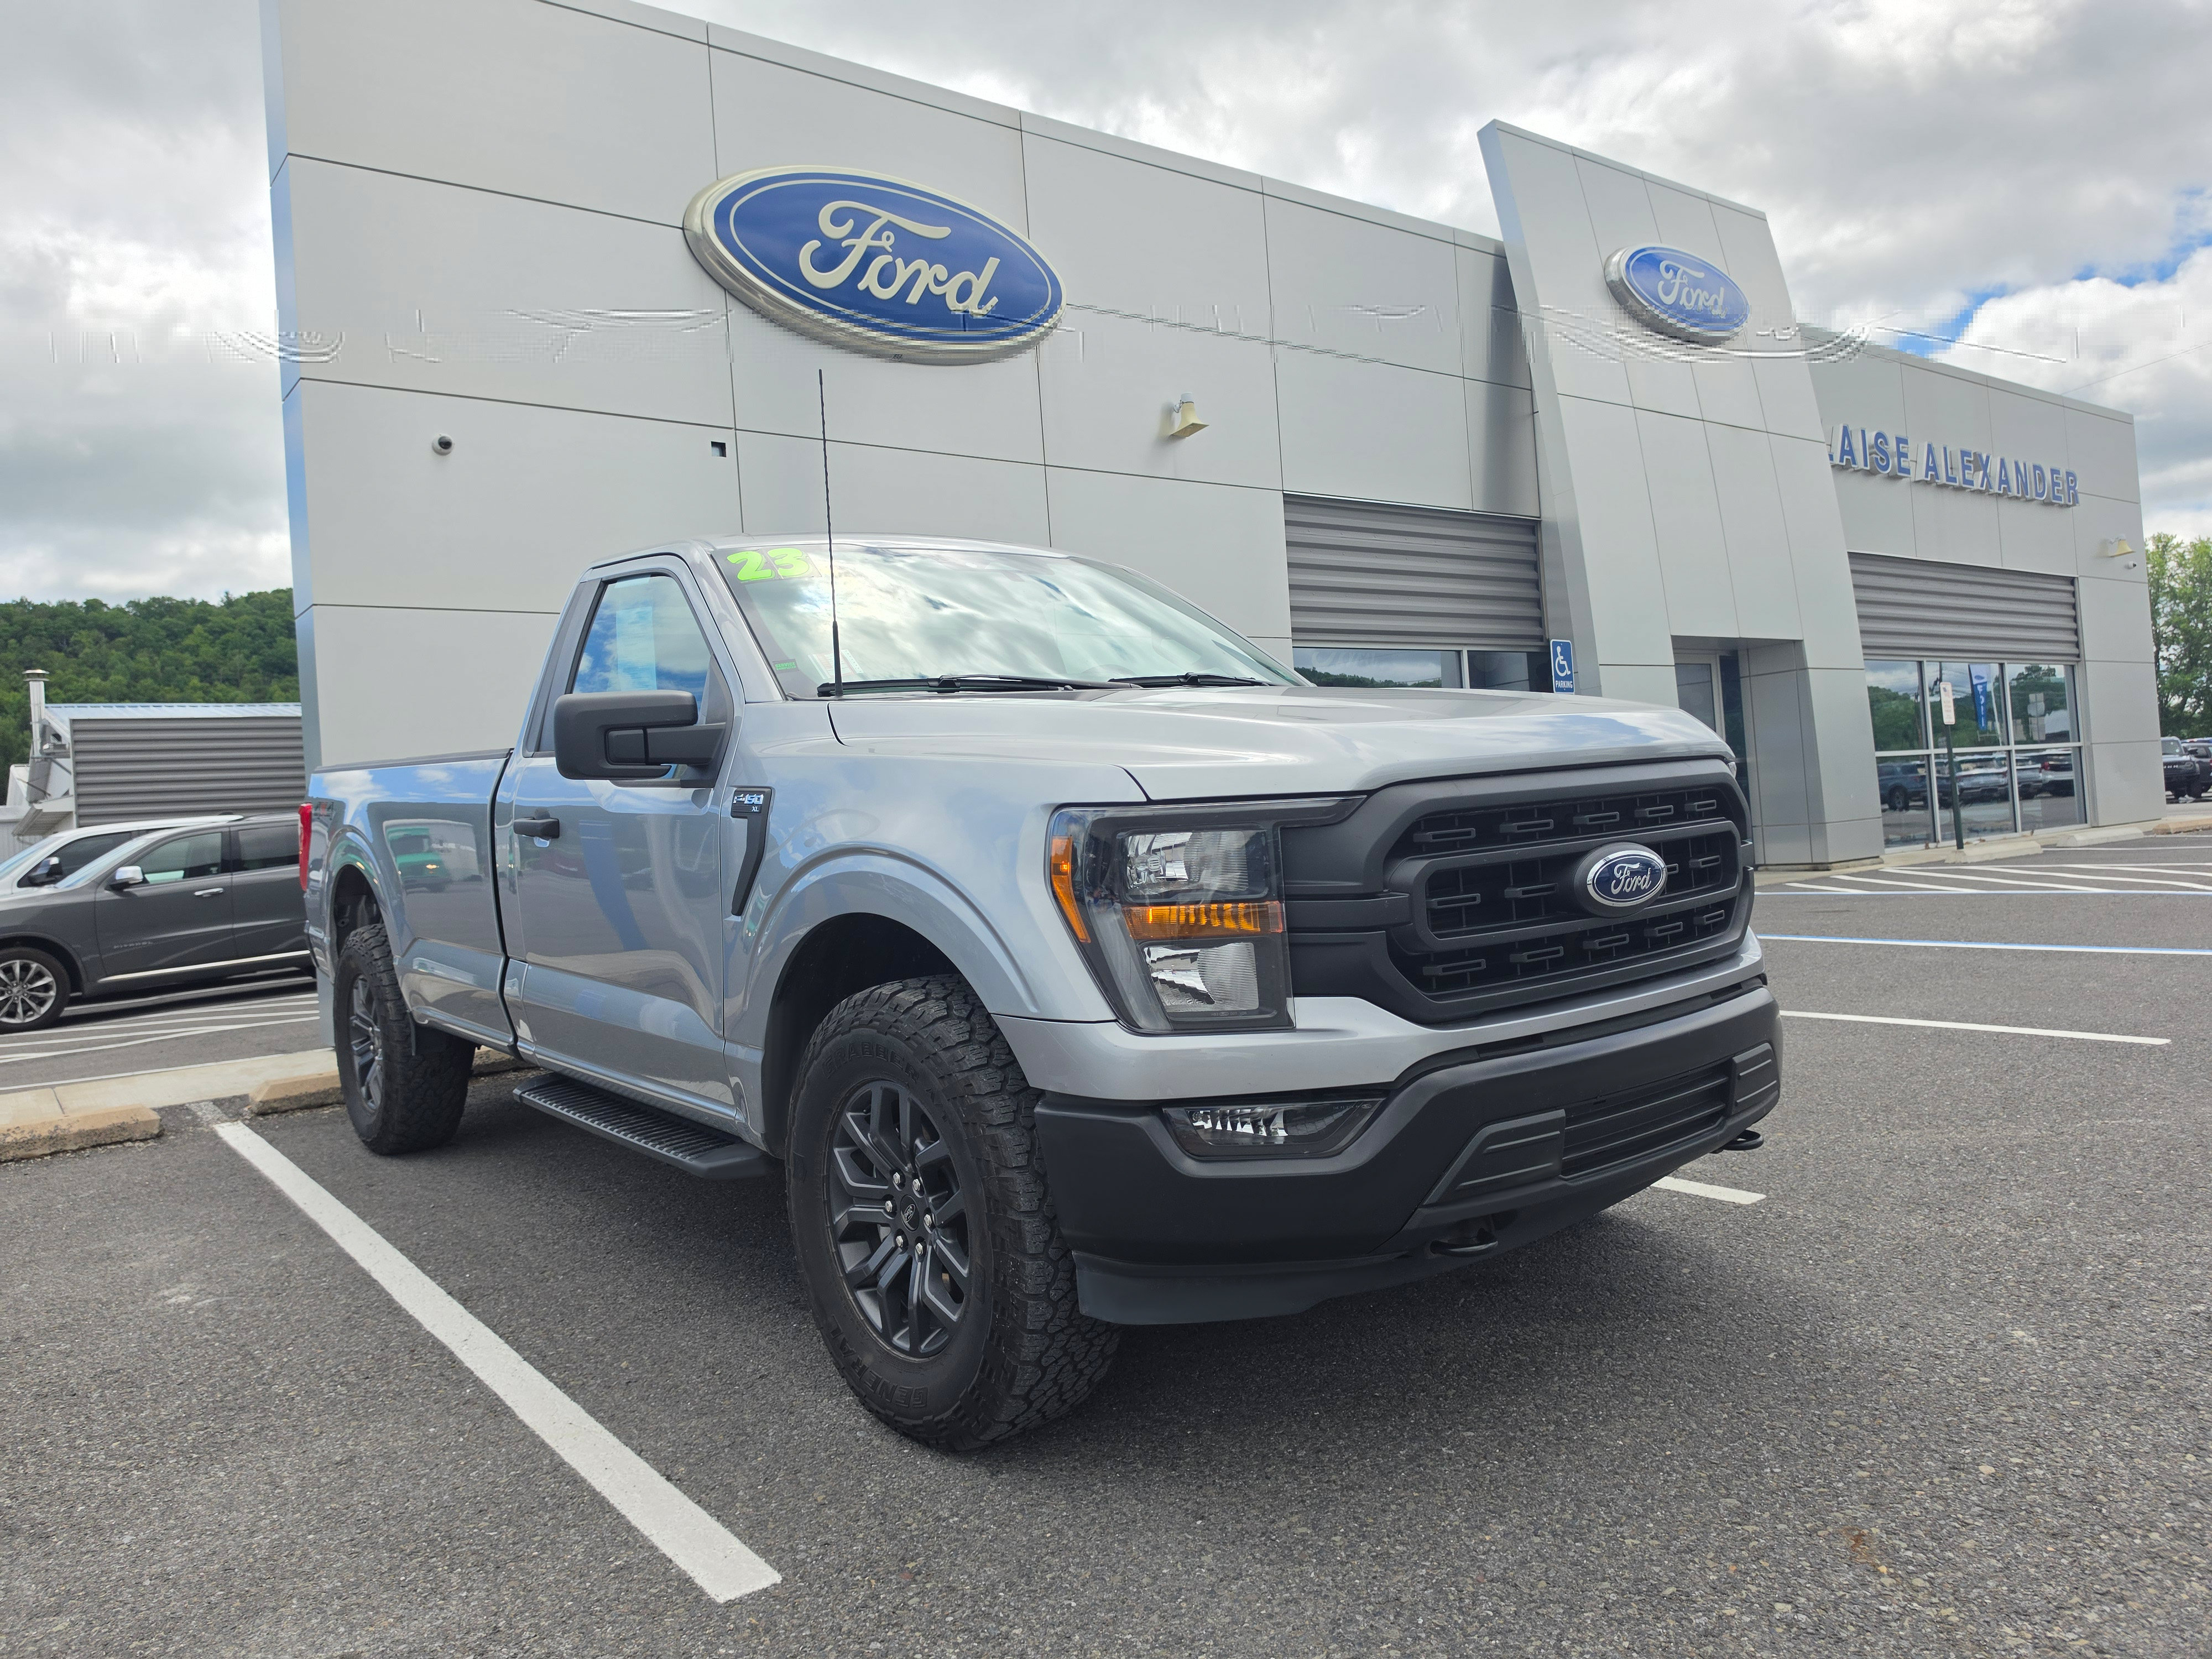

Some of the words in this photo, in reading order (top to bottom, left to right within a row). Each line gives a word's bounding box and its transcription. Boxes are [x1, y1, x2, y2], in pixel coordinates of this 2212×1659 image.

[799, 200, 1000, 317] Ford
[1657, 260, 1728, 318] Ford
[1828, 422, 1911, 477] AISE
[1924, 441, 2080, 505] ALEXANDER
[727, 547, 809, 580] 23
[1555, 680, 1573, 688] PARKING
[1611, 862, 1652, 894] Ford
[823, 1041, 919, 1083] GRABBER
[830, 1314, 928, 1408] GENERAL
